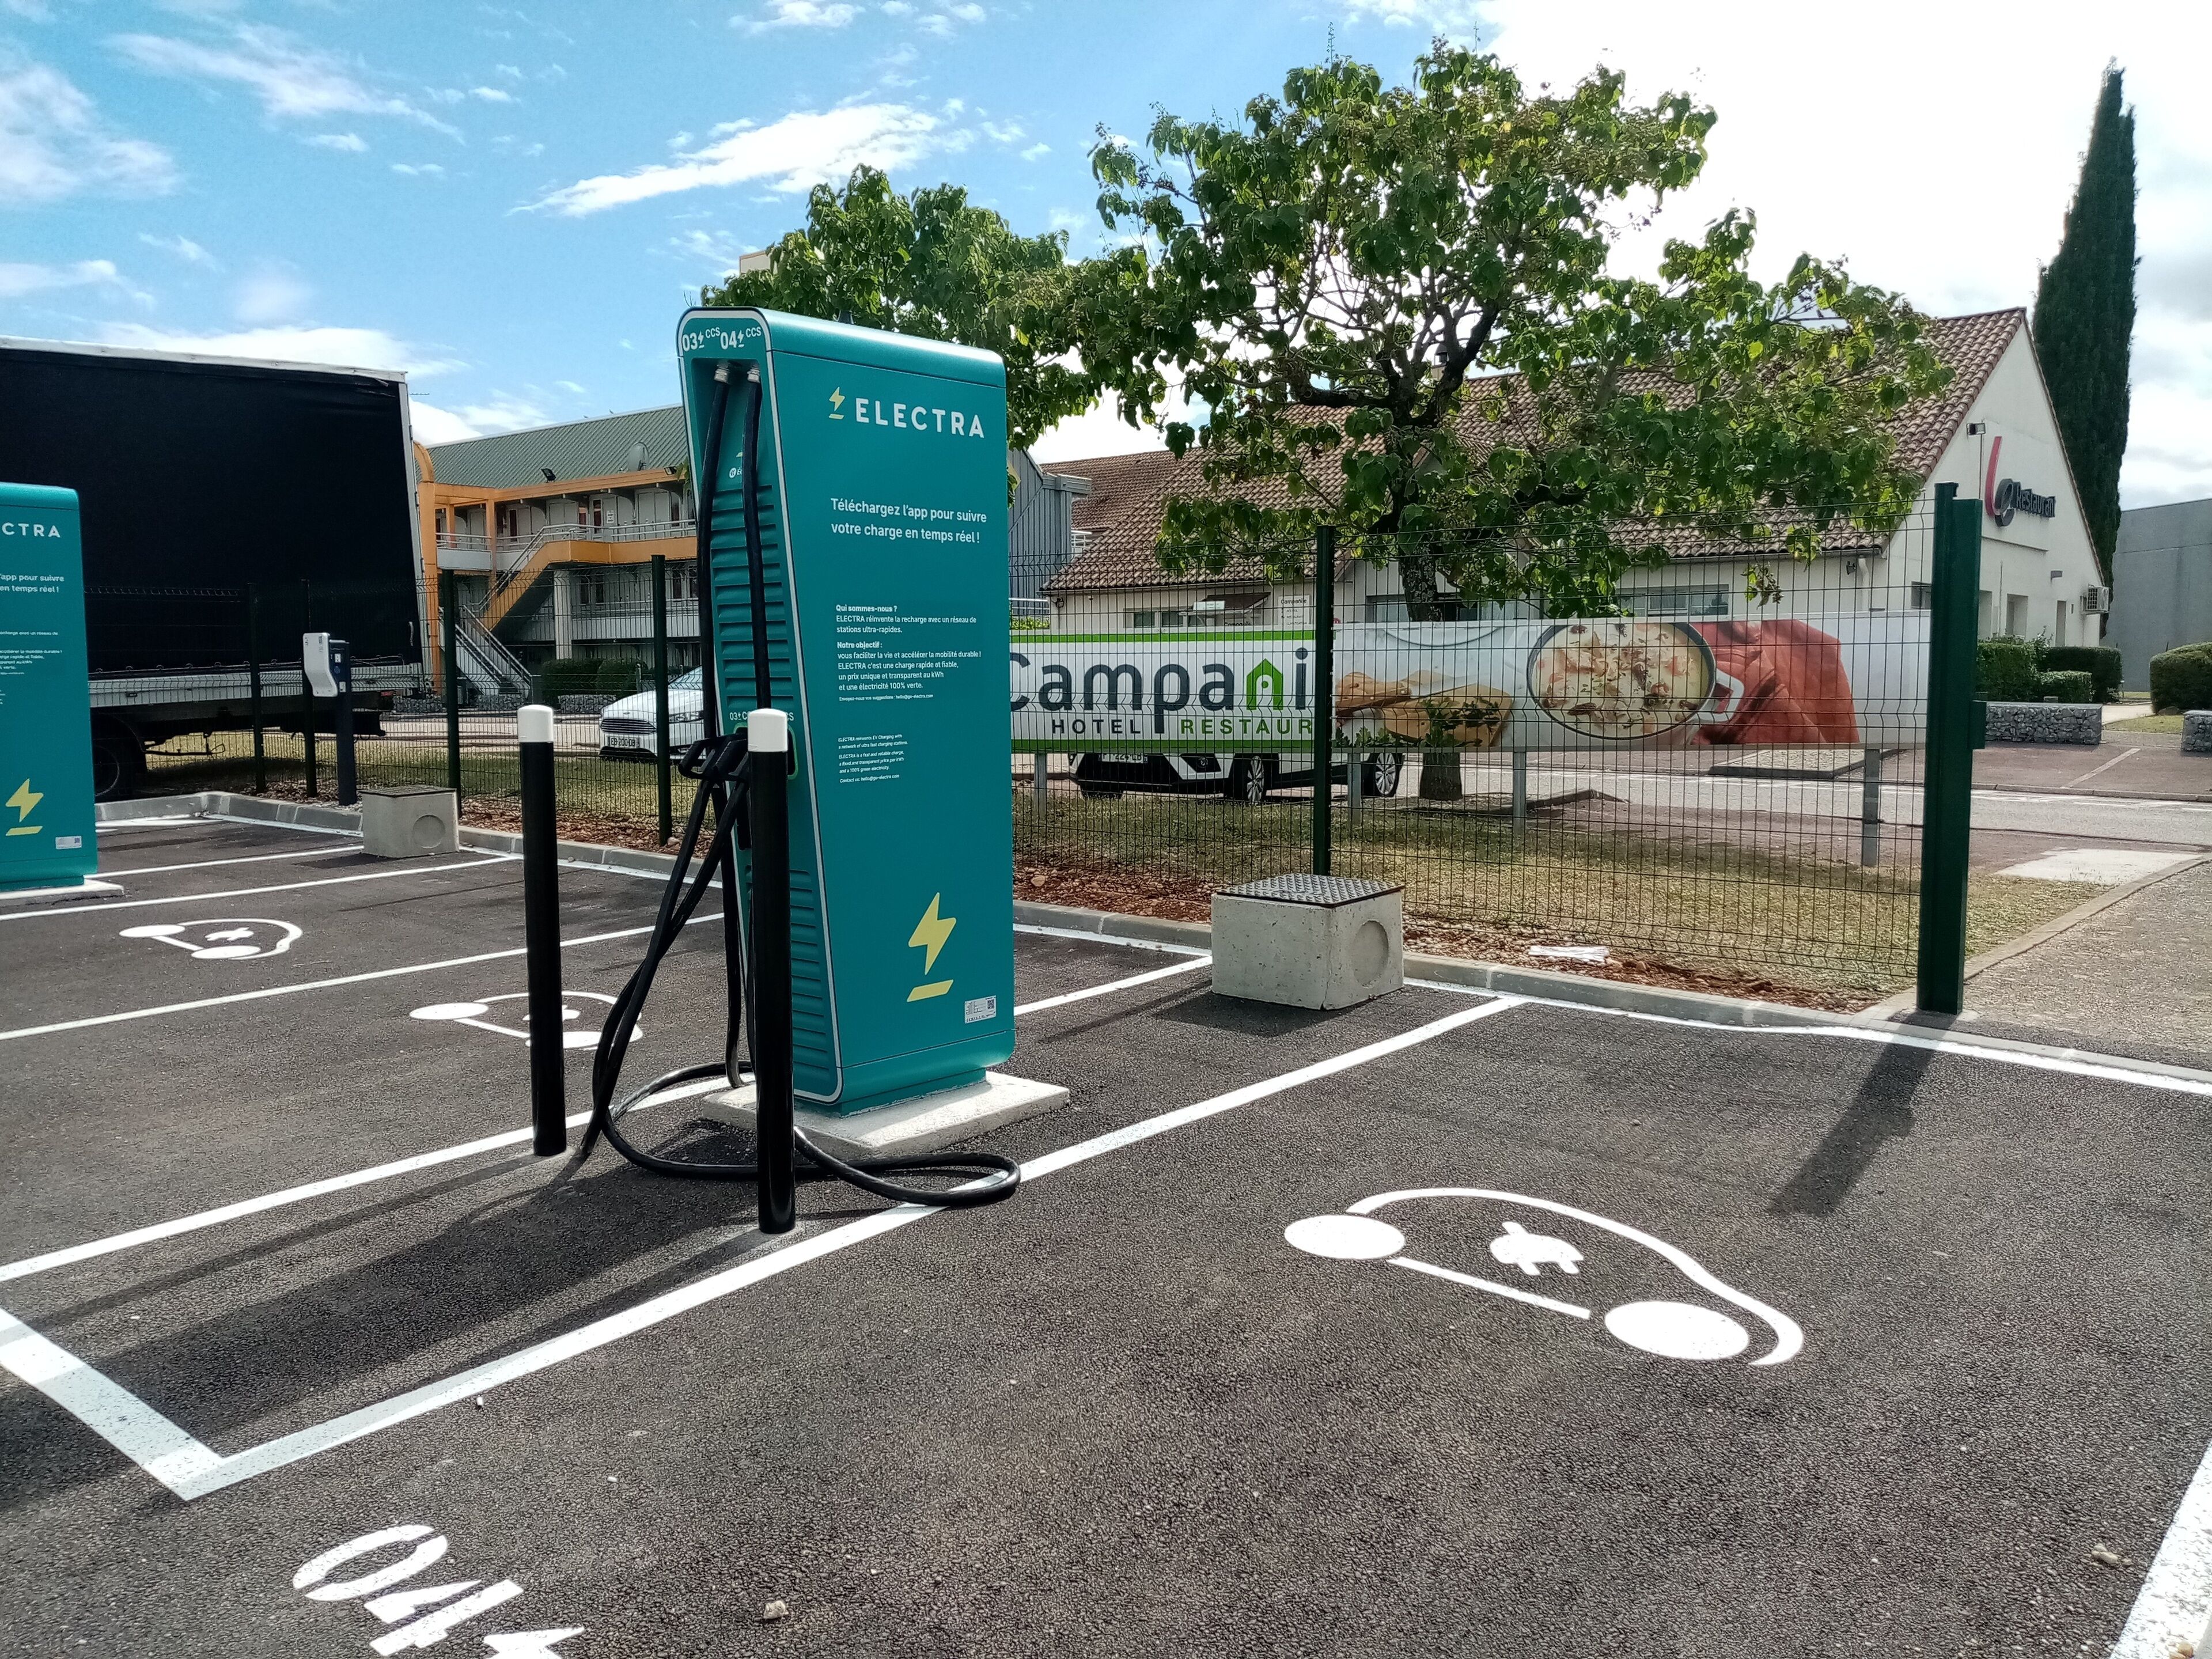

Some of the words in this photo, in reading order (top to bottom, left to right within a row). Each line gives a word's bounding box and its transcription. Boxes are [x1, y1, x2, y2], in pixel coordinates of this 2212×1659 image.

[682, 332, 698, 351] 03
[706, 327, 720, 338] CCS
[721, 331, 737, 350] 04
[746, 327, 761, 338] CCS
[855, 398, 984, 438] ELECTRA
[831, 498, 900, 517] Téléchargez
[903, 505, 927, 520] l'app
[931, 510, 954, 521] pour
[957, 510, 986, 522] suivre
[2, 522, 60, 537] CTRA
[831, 523, 861, 535] votre
[865, 524, 902, 540] charge
[906, 529, 918, 539] en
[921, 529, 953, 543] temps
[956, 531, 975, 543] réel
[977, 532, 979, 543] !
[855, 641, 879, 649] objectif
[916, 661, 934, 669] rapide
[848, 673, 859, 681] prix
[861, 673, 880, 681] unique
[729, 712, 738, 721] 03
[1052, 719, 1141, 734] HOTEL
[293, 1525, 524, 1656] 04
